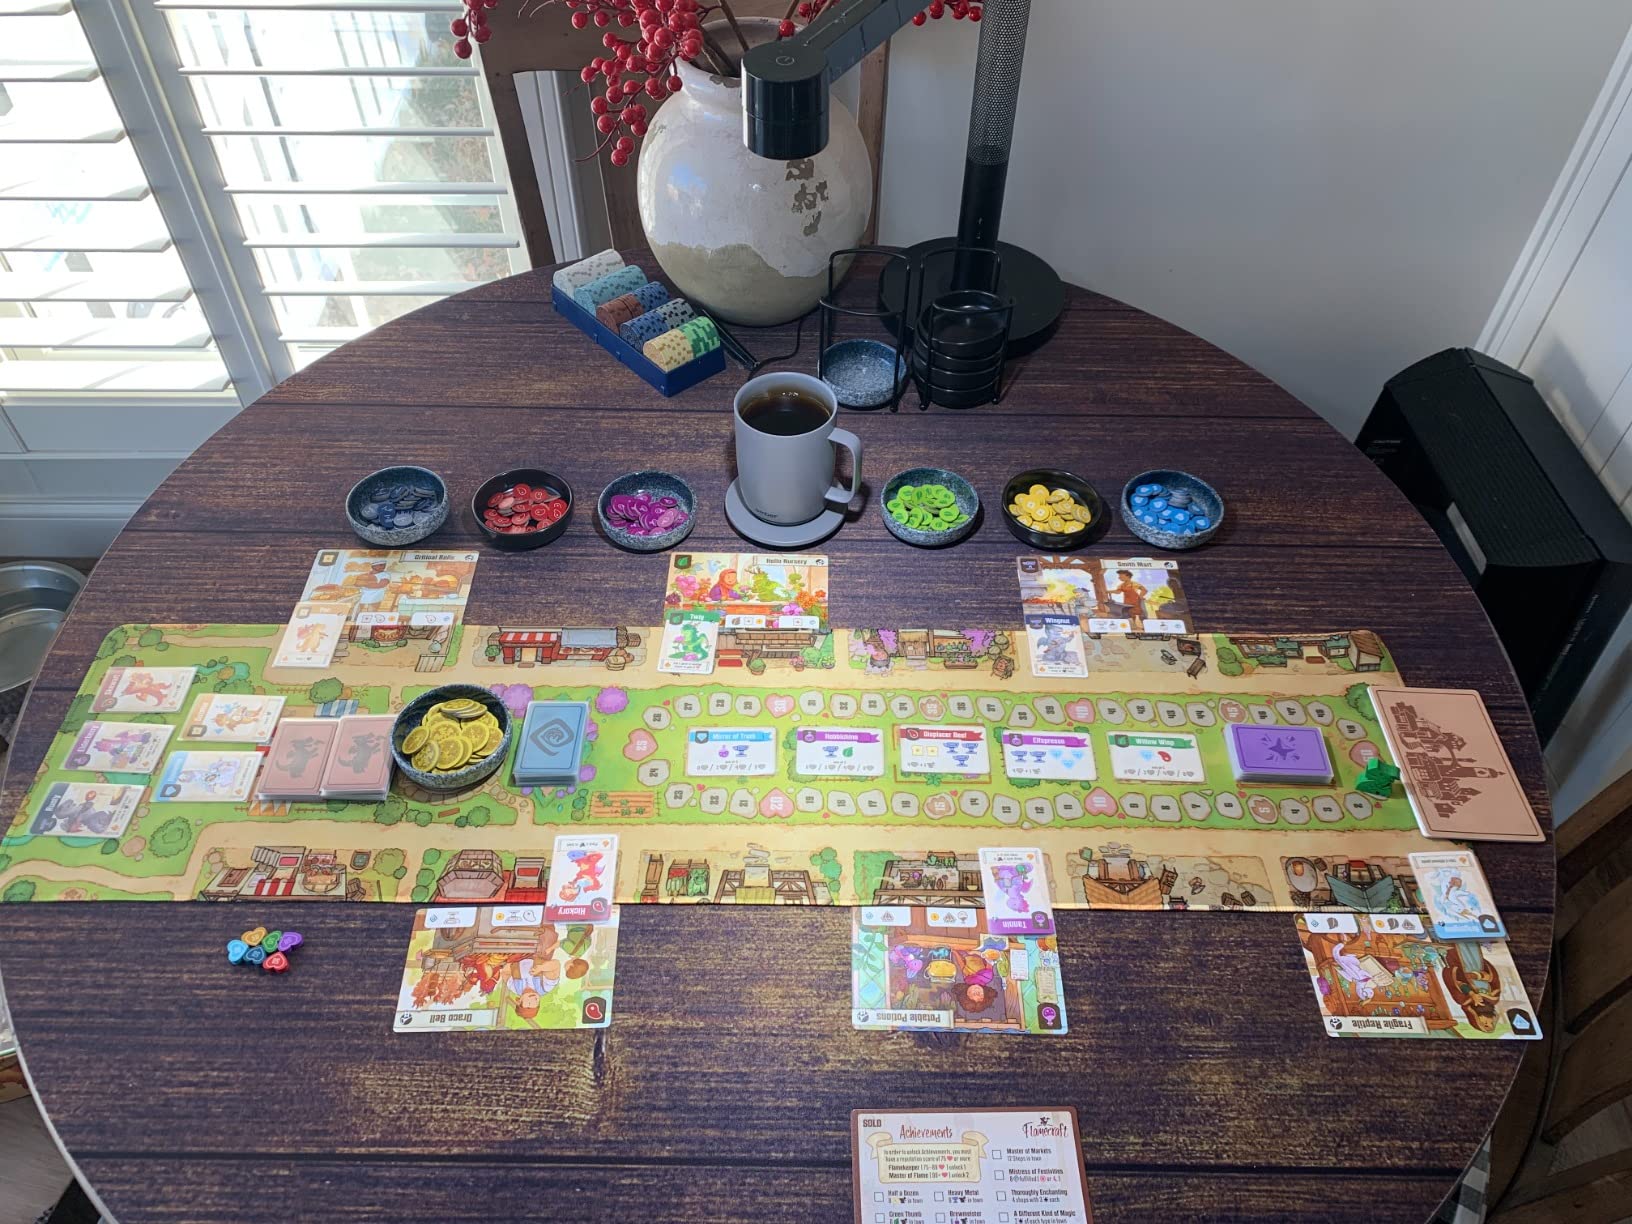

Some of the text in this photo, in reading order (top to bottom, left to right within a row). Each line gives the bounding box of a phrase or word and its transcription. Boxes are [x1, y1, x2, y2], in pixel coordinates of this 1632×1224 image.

[558, 907, 586, 915] Hickory
[1002, 920, 1027, 929] Tannin
[429, 1014, 473, 1023] Draco Bell
[876, 1012, 941, 1022] Potable Potions
[1352, 1018, 1412, 1030] Fragile Reptile
[899, 1125, 953, 1139] Achievements
[1022, 1122, 1069, 1138] Flamecraft
